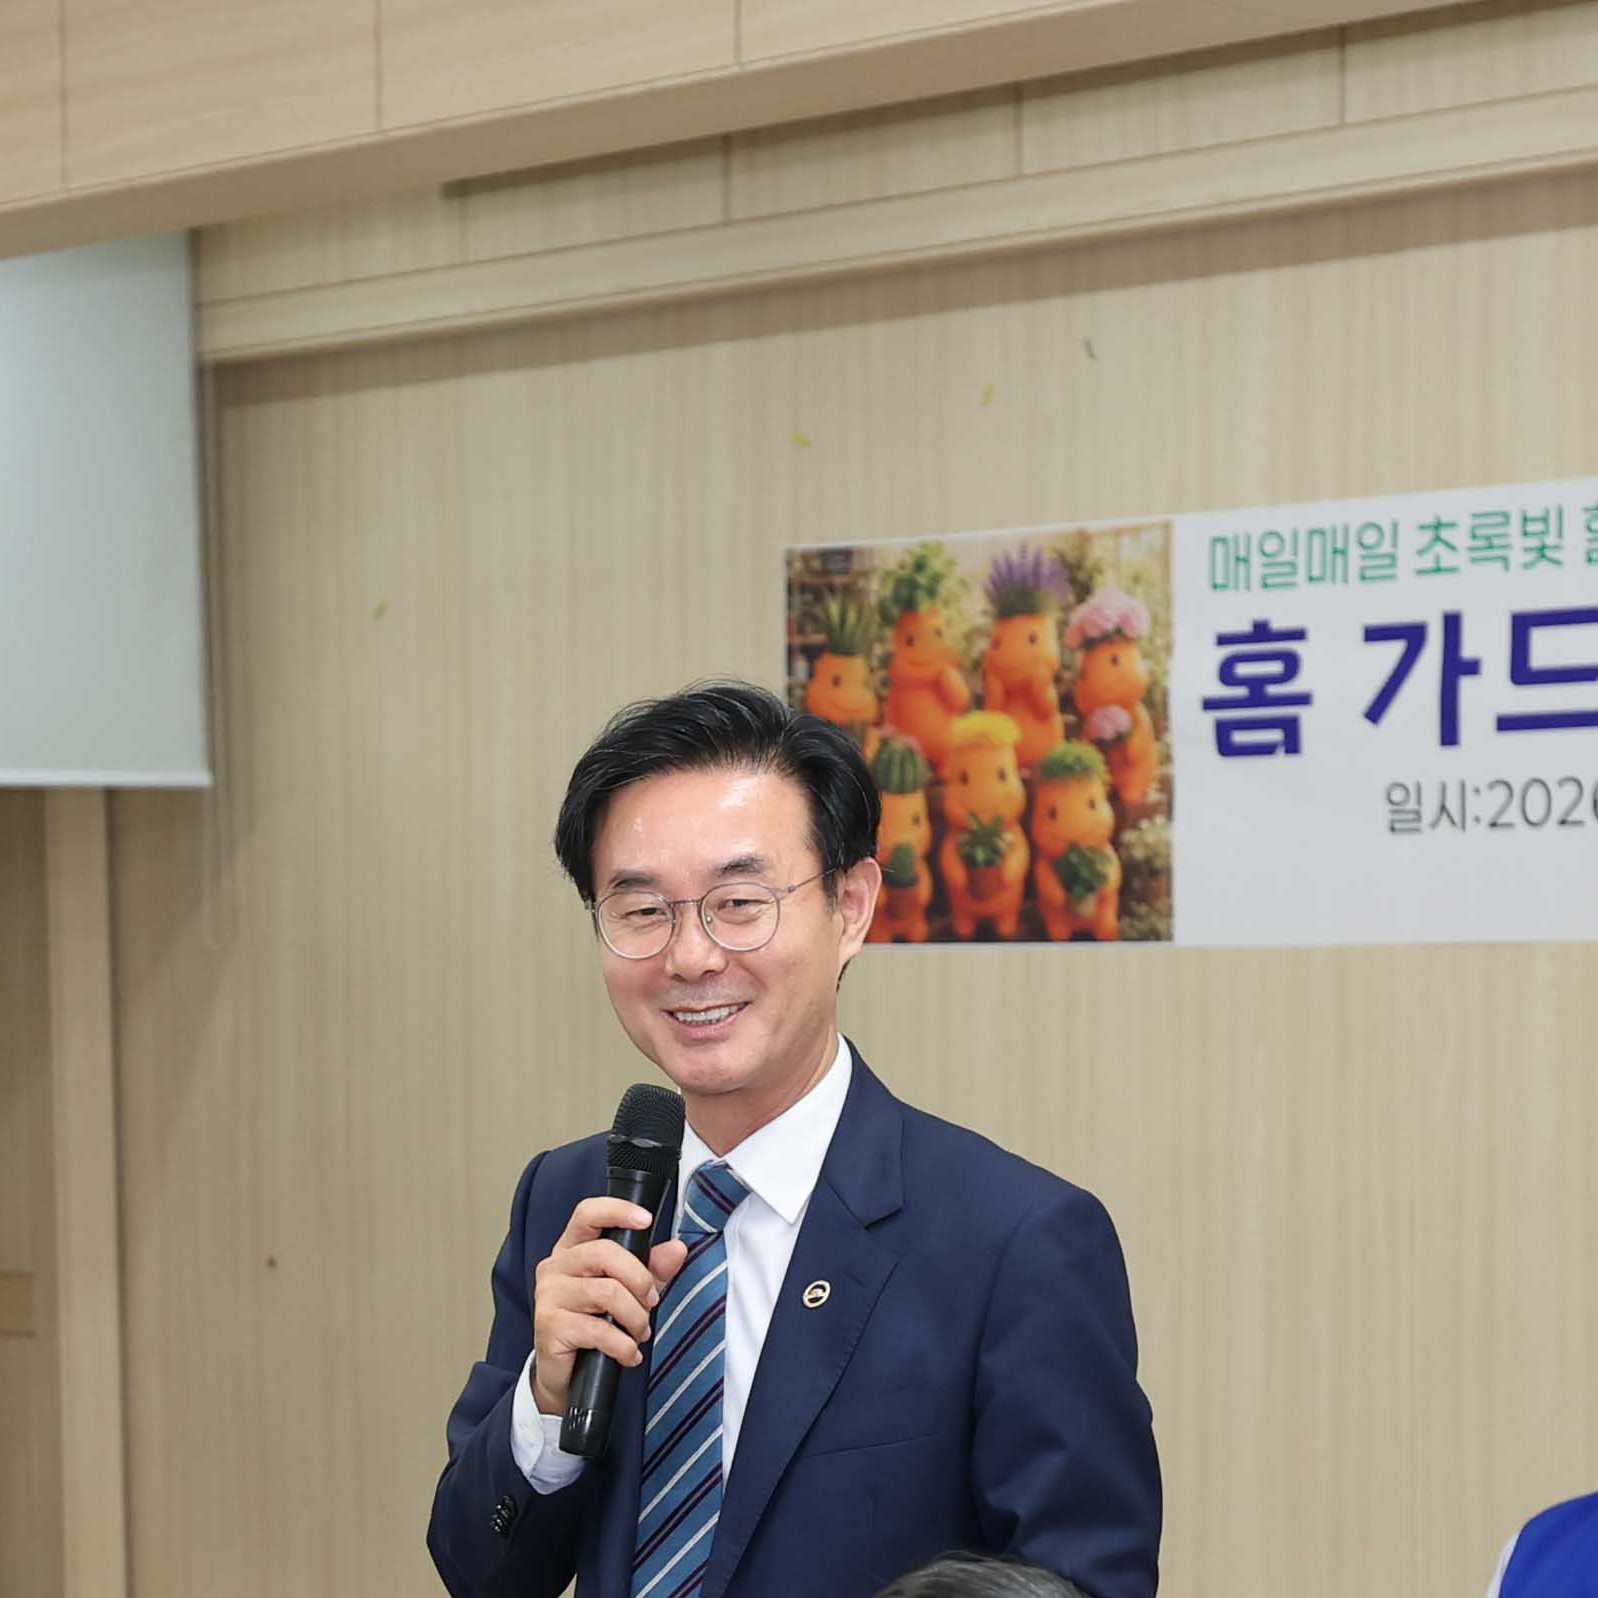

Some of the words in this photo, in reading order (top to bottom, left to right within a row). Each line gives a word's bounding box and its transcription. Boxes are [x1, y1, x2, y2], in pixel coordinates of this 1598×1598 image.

[1209, 519, 1399, 592] 매일매일
[1413, 504, 1565, 577] 초록빛
[1200, 618, 1315, 760] 홈
